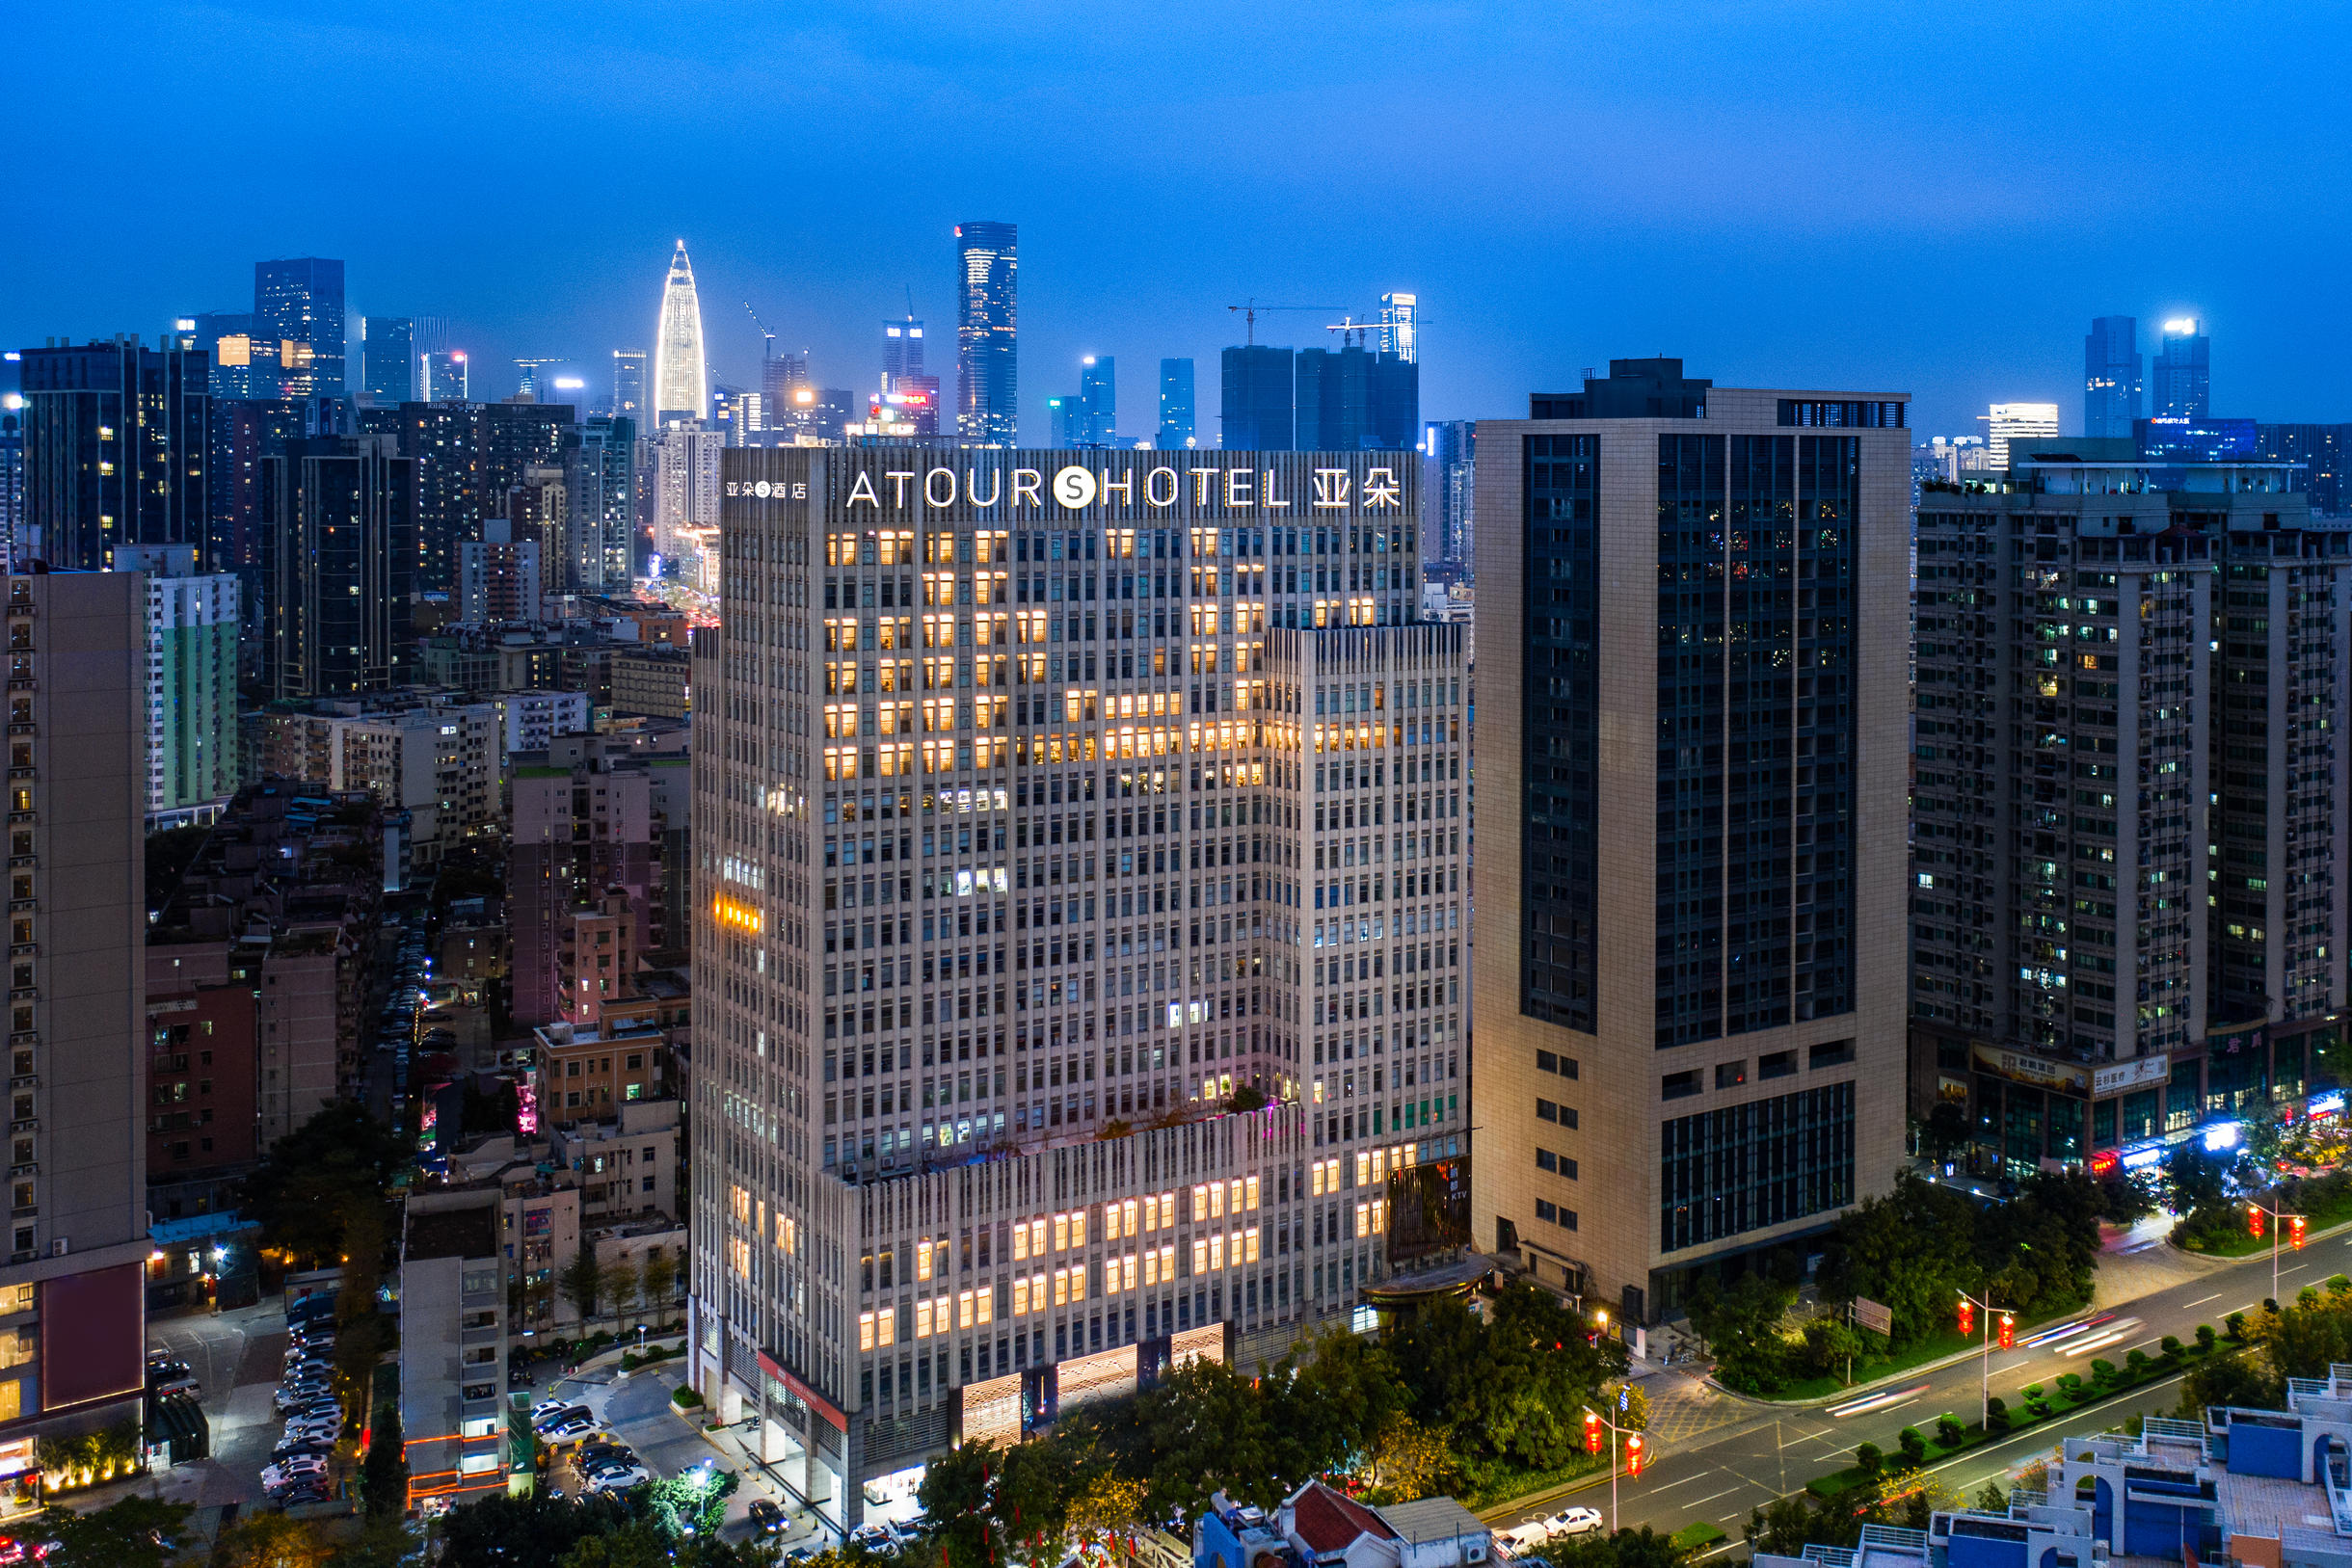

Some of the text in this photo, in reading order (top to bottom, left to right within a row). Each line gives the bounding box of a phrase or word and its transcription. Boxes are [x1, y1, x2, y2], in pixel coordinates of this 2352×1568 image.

[846, 466, 1042, 509] ATOUR
[1100, 466, 1291, 508] HOTEL
[1313, 467, 1401, 509] 亚朵
[1451, 1190, 1467, 1202] KTV
